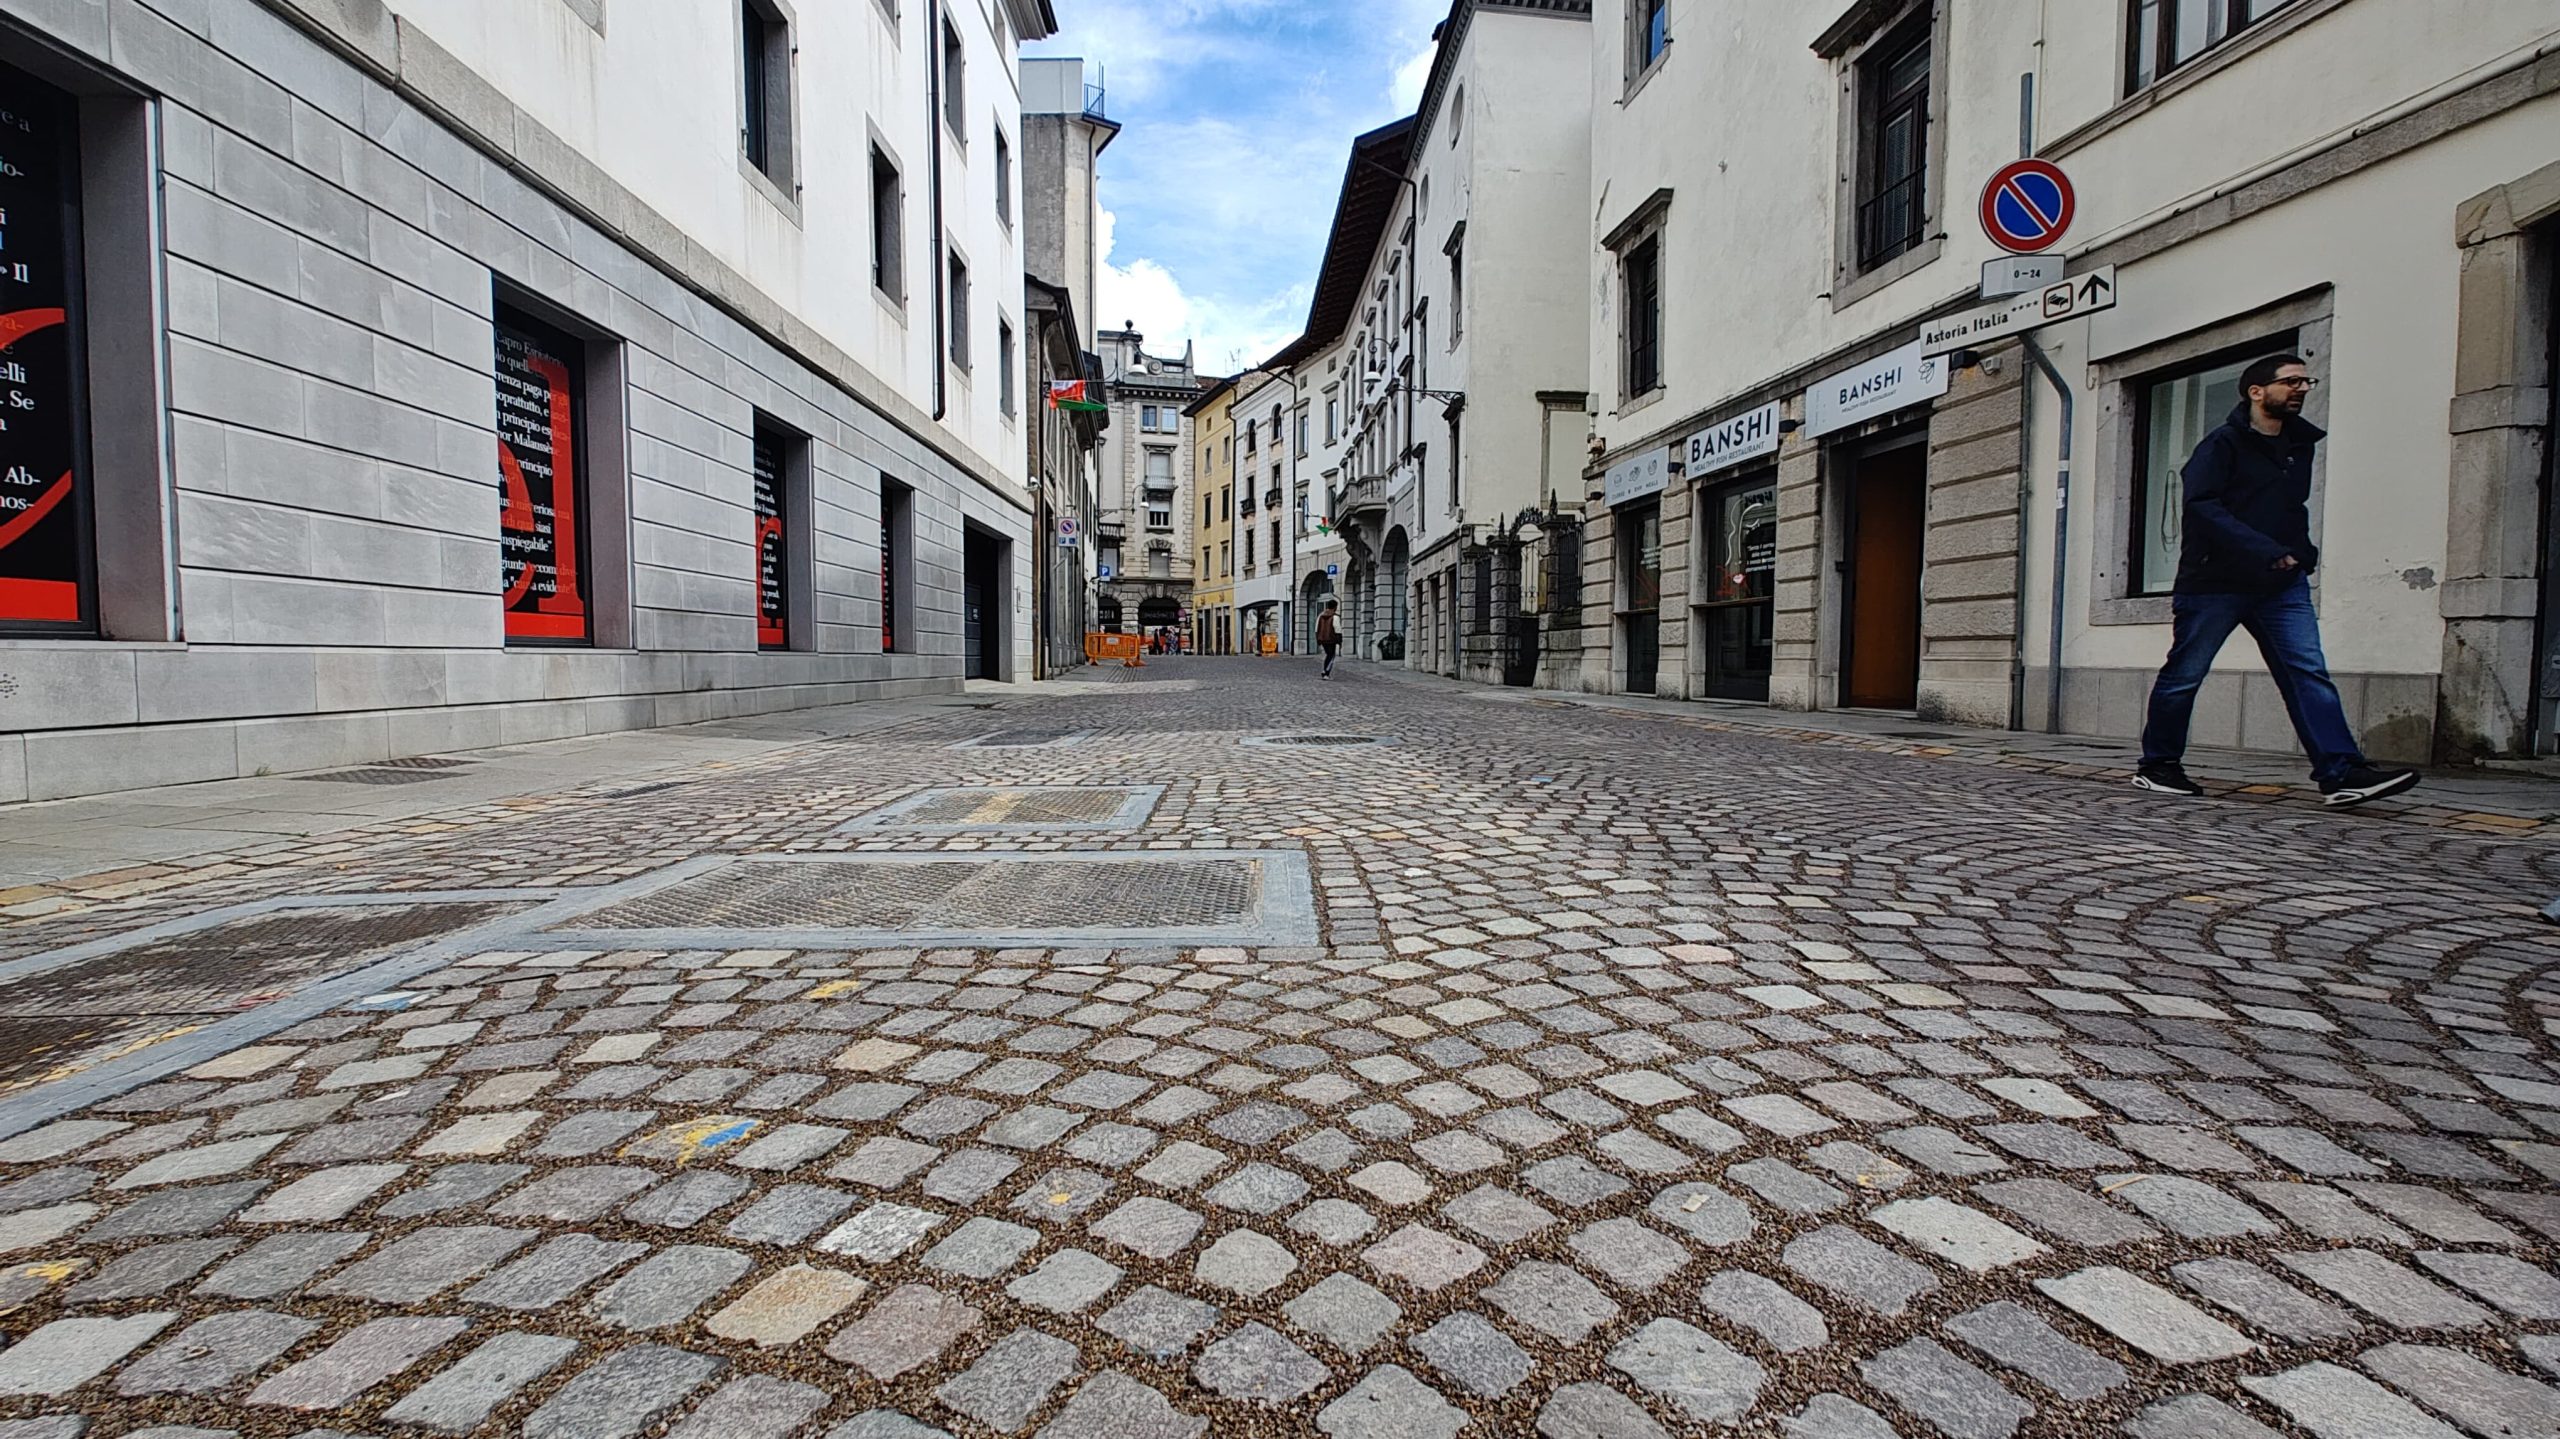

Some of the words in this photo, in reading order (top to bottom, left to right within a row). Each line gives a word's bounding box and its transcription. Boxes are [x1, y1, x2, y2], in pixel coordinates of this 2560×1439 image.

[1925, 324, 1968, 346] Astoria
[1973, 311, 2009, 332] Italia
[494, 329, 523, 351] Capro
[522, 381, 543, 399] paga
[1838, 366, 1902, 405] BANSHI
[9, 389, 35, 411] Se
[502, 412, 541, 434] principio
[1691, 408, 1771, 463] BANSHI
[4, 466, 42, 486] Ab-
